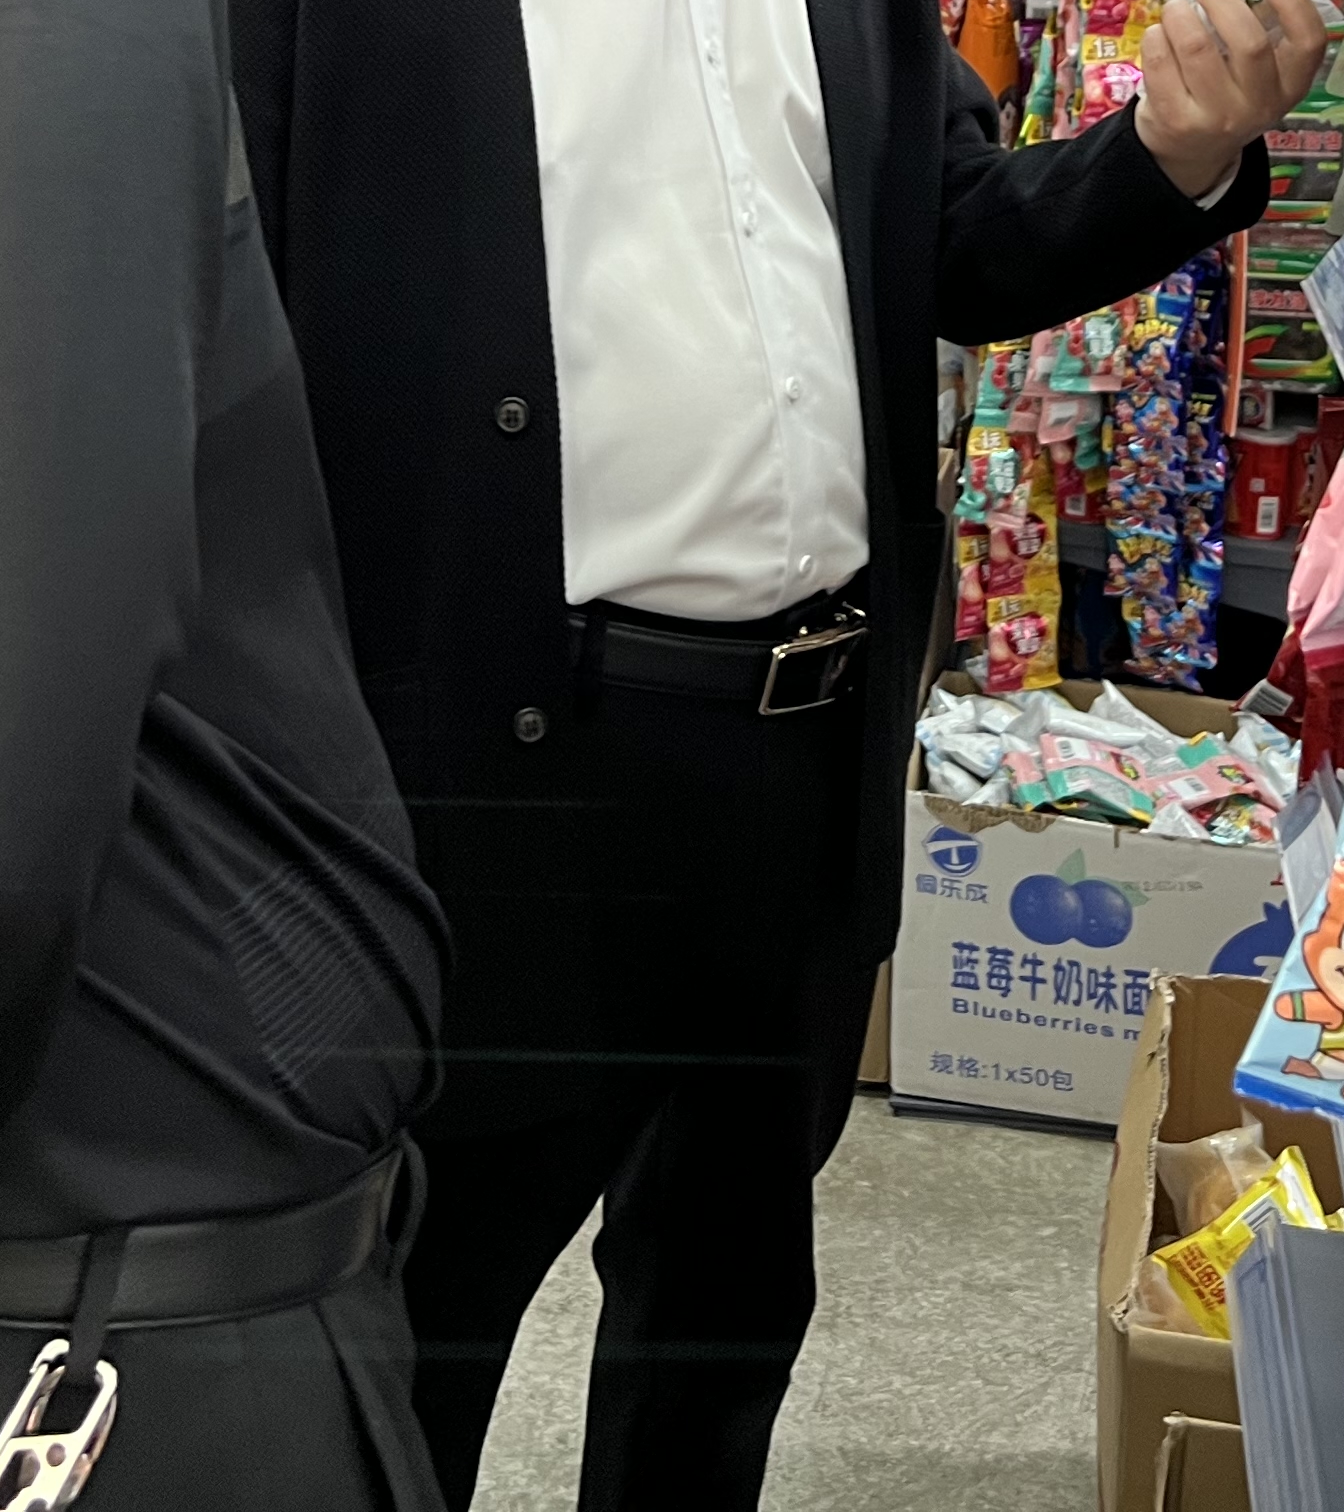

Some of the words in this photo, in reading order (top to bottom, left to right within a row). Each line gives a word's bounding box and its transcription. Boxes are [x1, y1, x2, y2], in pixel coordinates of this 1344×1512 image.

[950, 941, 1151, 1017] 蓝莓牛奶味面
[951, 998, 1115, 1039] Blueberries
